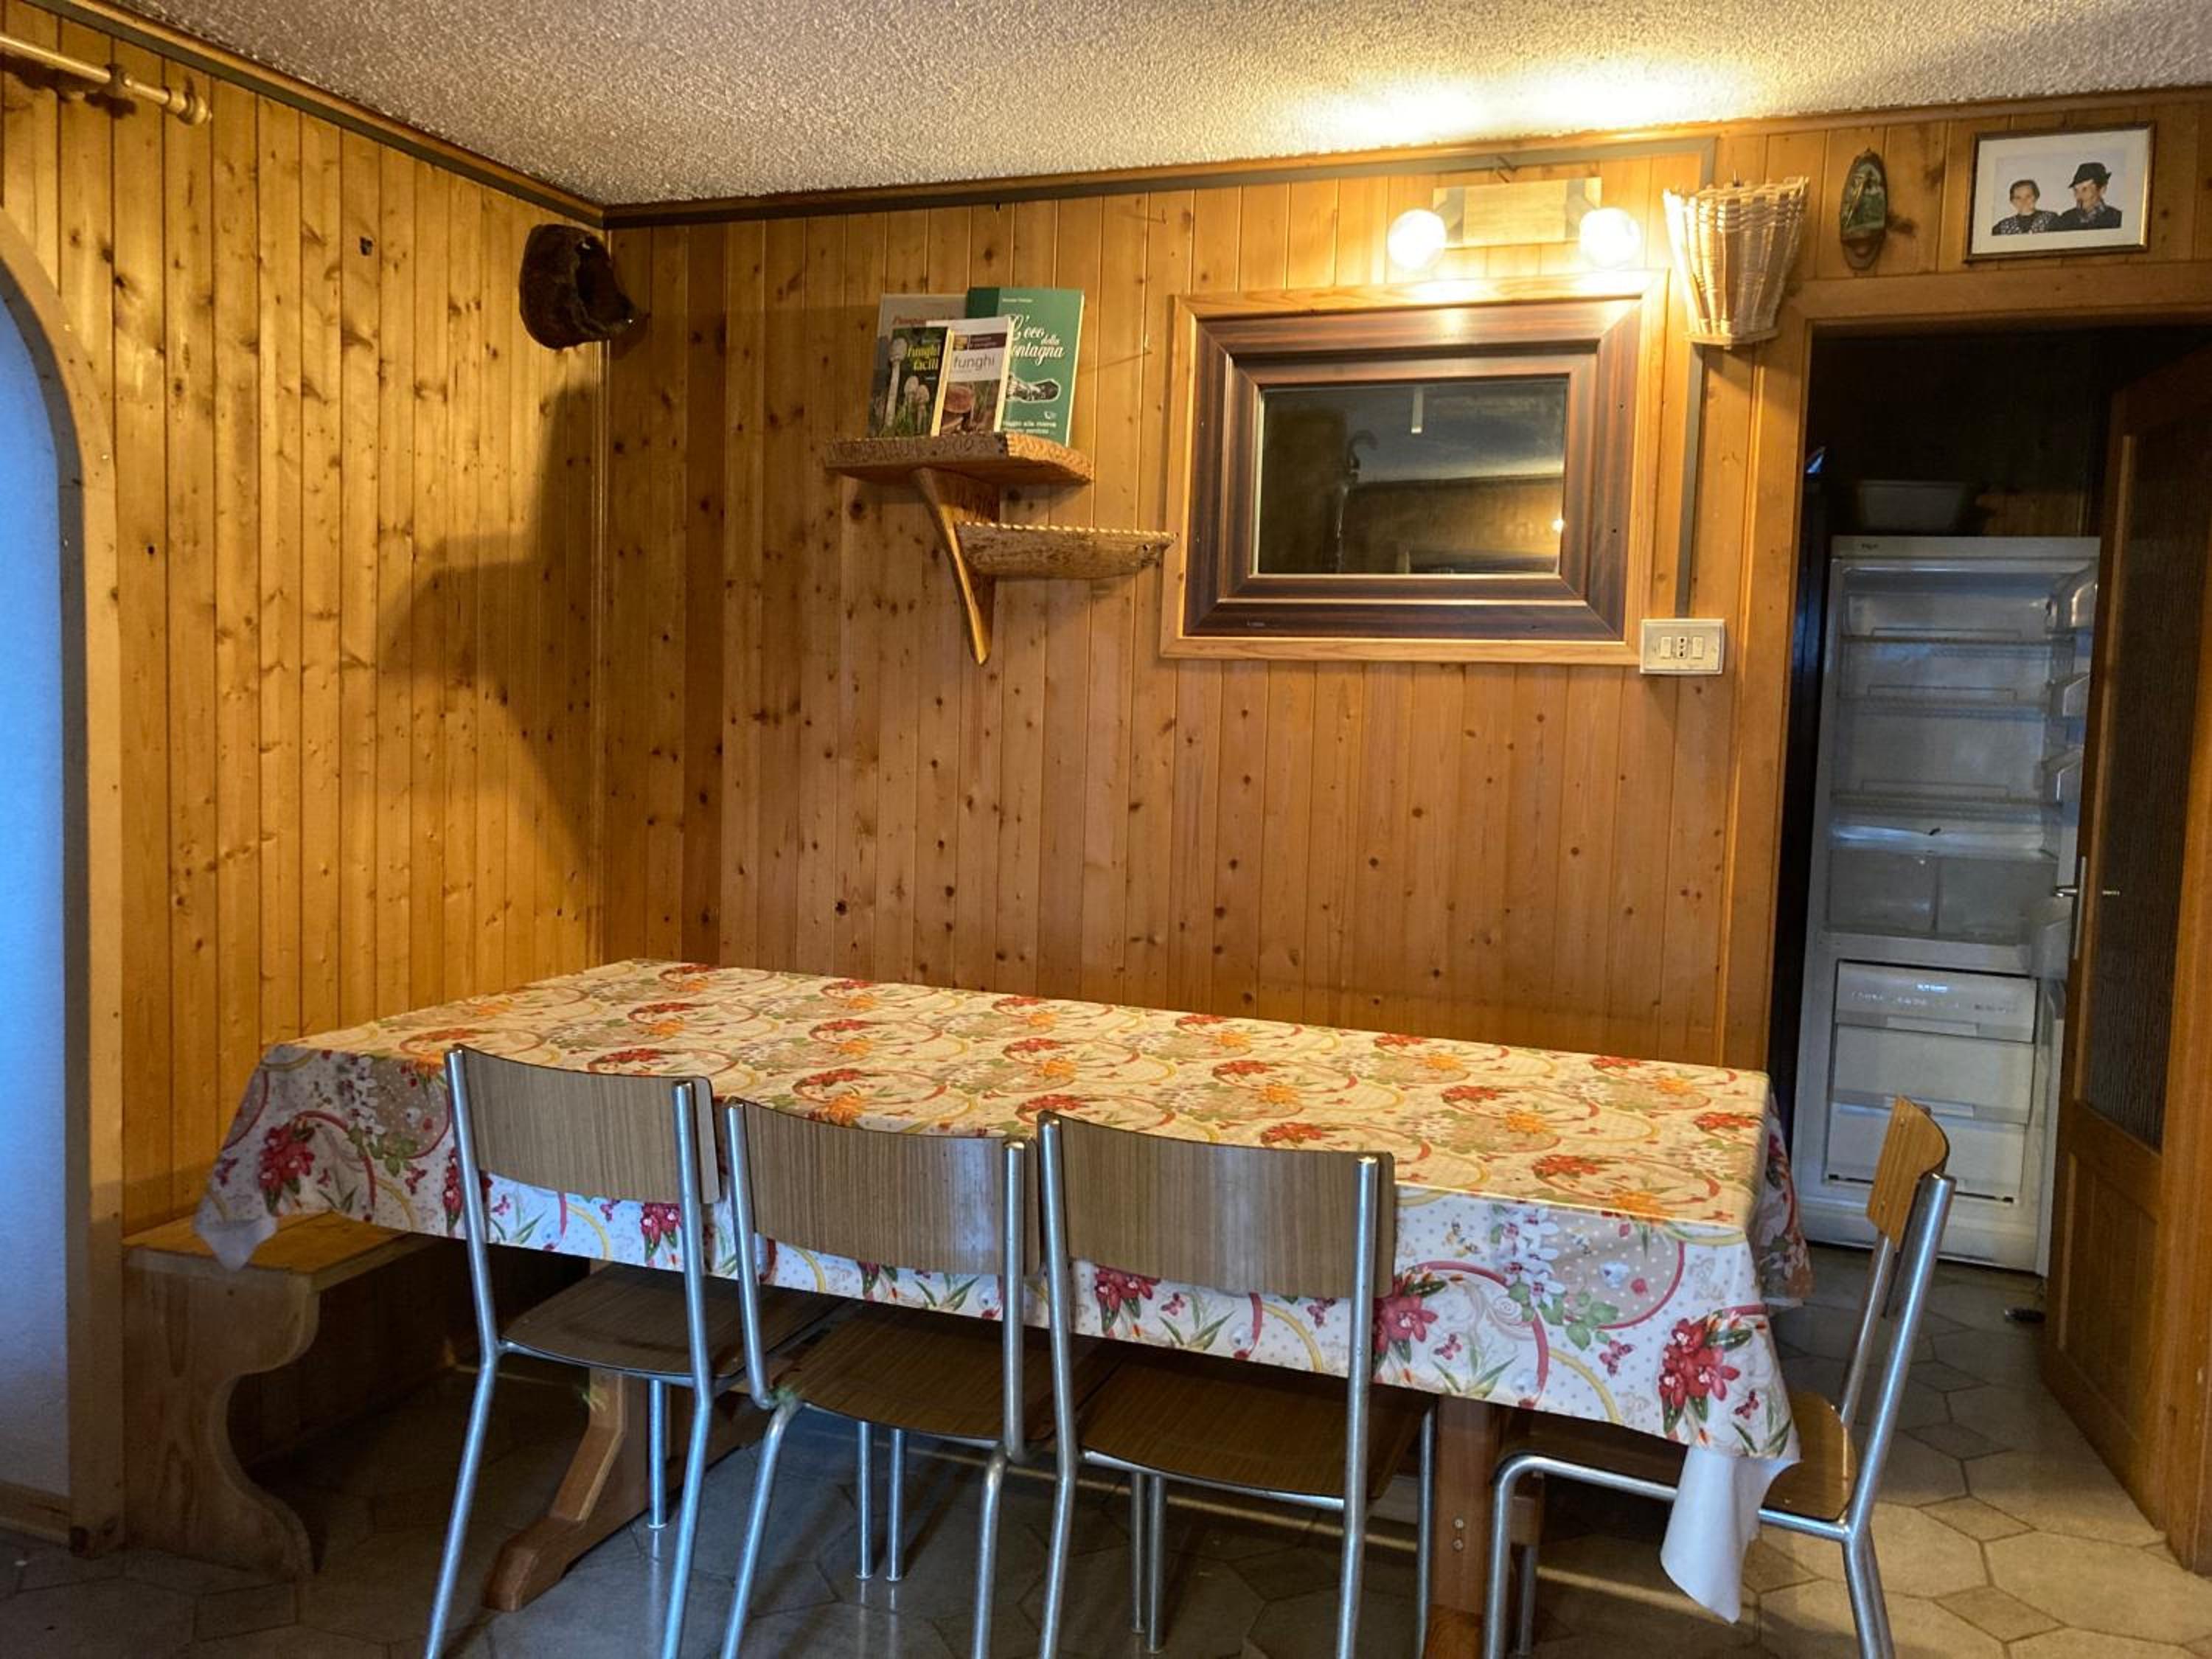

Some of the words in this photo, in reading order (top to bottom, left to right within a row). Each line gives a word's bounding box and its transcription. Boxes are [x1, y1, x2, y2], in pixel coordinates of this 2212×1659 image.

[907, 344, 941, 360] funghi
[1012, 341, 1065, 366] ontagna
[914, 358, 939, 370] facili
[953, 354, 995, 371] funghi
